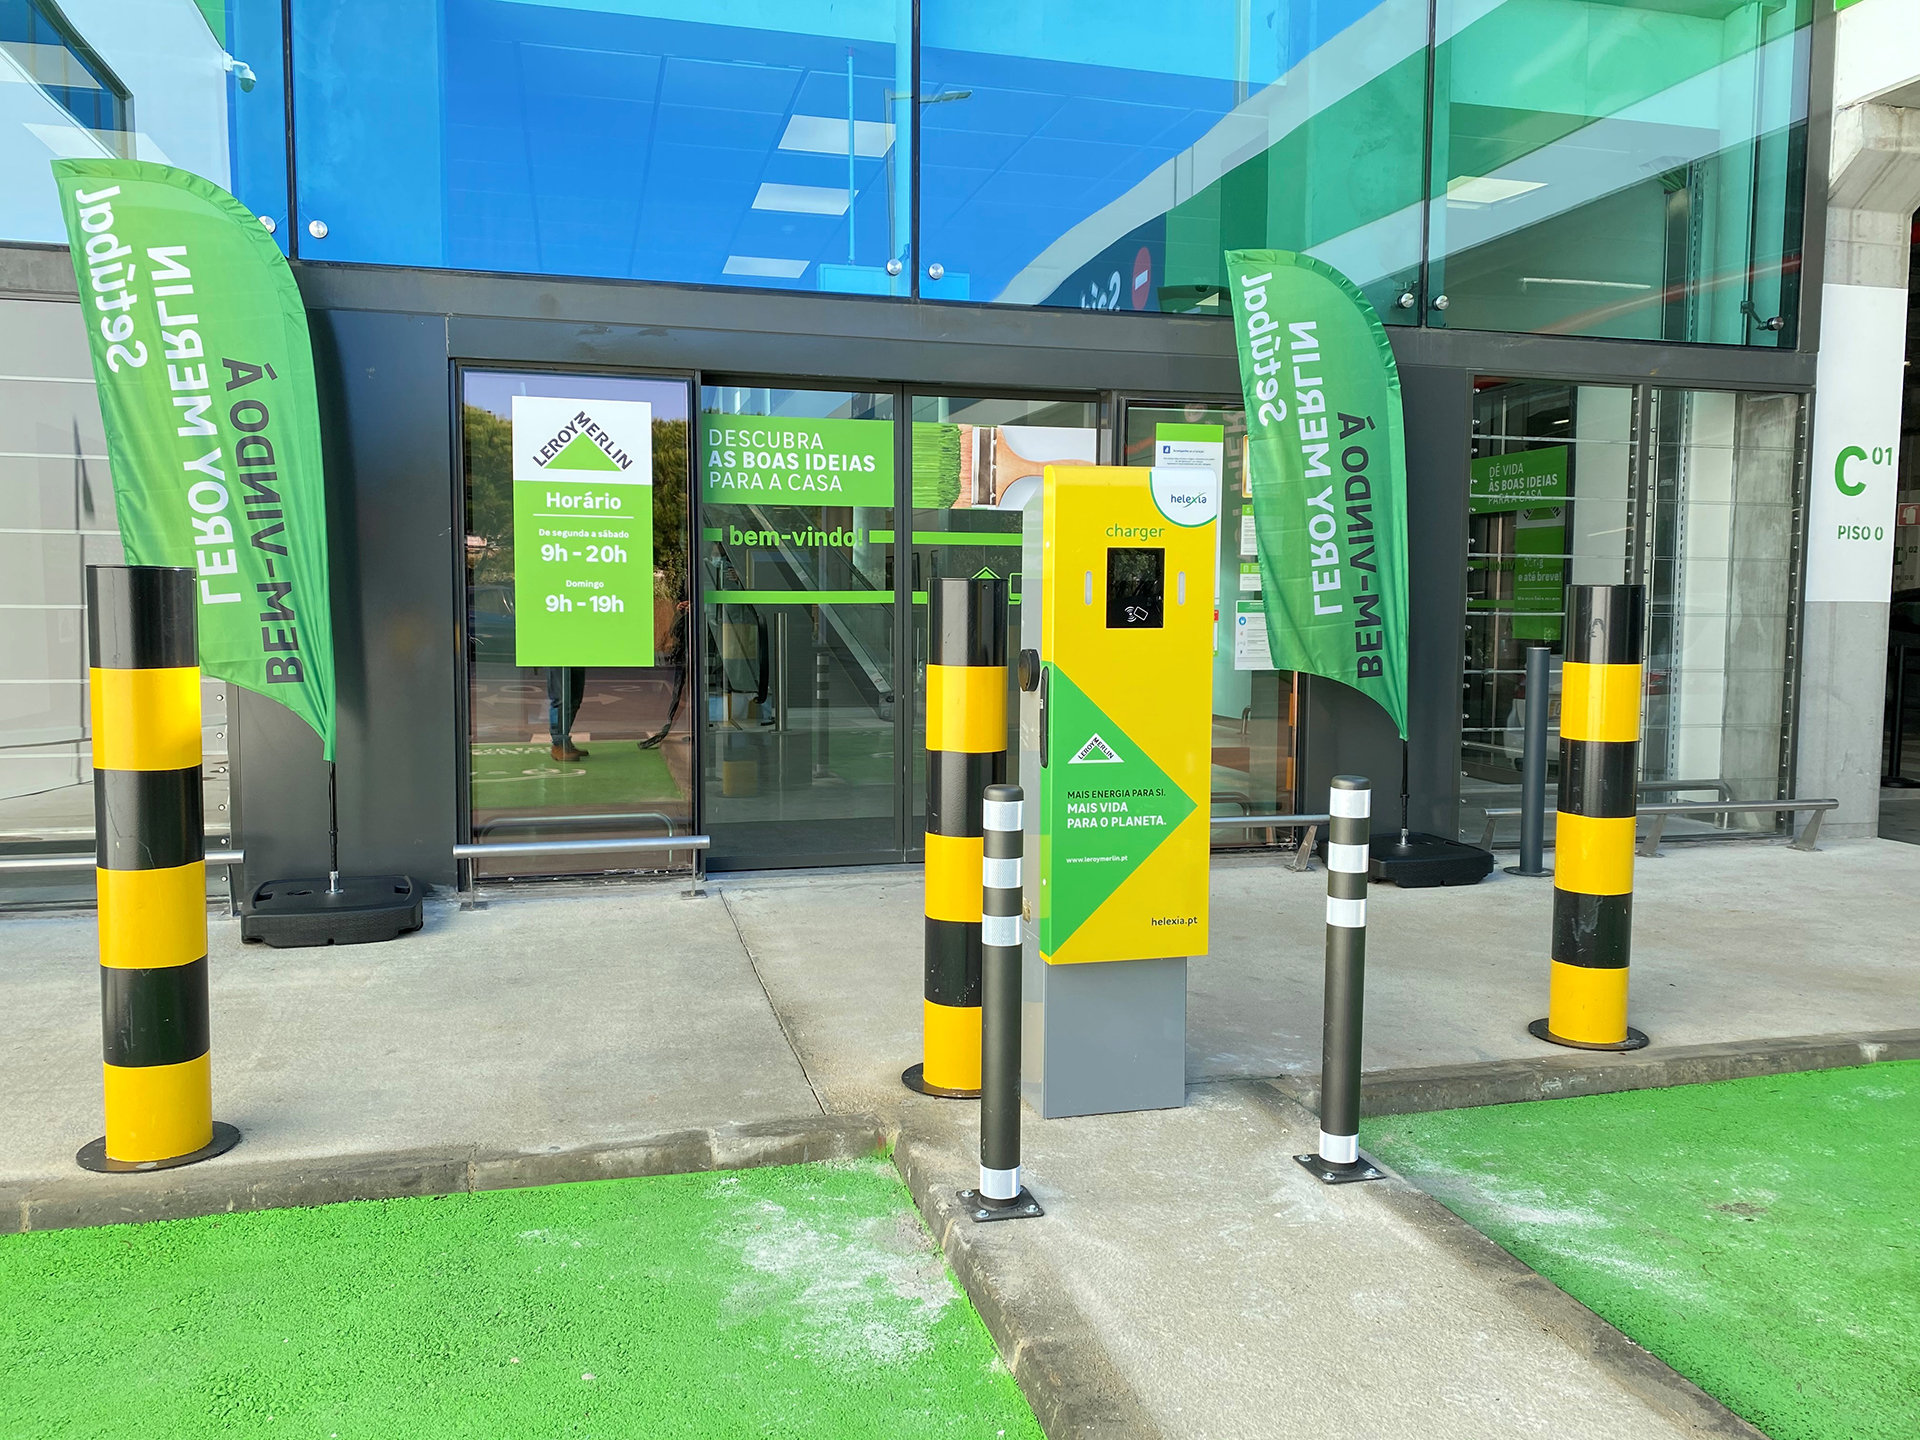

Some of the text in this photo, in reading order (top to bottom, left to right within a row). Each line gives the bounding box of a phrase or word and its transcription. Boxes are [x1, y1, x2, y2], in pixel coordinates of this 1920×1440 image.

[532, 410, 633, 471] LEROY MERLIN
[708, 428, 823, 450] DESCUBRA
[708, 450, 876, 472] AS BOAS IDEIAS
[1489, 463, 1524, 477] DÊ VIDA
[1834, 446, 1893, 496] C 01
[709, 471, 843, 492] PARA A CASA
[1501, 478, 1525, 491] BOAS
[1527, 474, 1558, 488] IDEIAS
[545, 490, 622, 511] Horário
[1170, 493, 1207, 507] helexia
[538, 528, 550, 537] De
[552, 528, 589, 539] segunda
[598, 528, 630, 539] sábado
[729, 524, 864, 547] bem-vindo!
[1105, 523, 1166, 541] charger
[1838, 526, 1884, 541] PISO 0
[541, 543, 568, 563] 9h
[585, 544, 628, 564] 20h
[565, 579, 604, 590] Domingo
[1524, 571, 1536, 581] até
[1537, 571, 1562, 581] breve!
[545, 594, 572, 613] 9h
[589, 594, 625, 614] 19h
[1078, 737, 1114, 760] LEROY MERLIN
[1092, 790, 1130, 798] ENERGIA
[1132, 789, 1154, 797] PARA
[1067, 802, 1128, 814] MAIS VIDA
[1067, 815, 1167, 829] PARA O PLANETA.
[1066, 854, 1128, 864] www.leroymerlin.pt
[1151, 916, 1198, 926] helexia.pt
